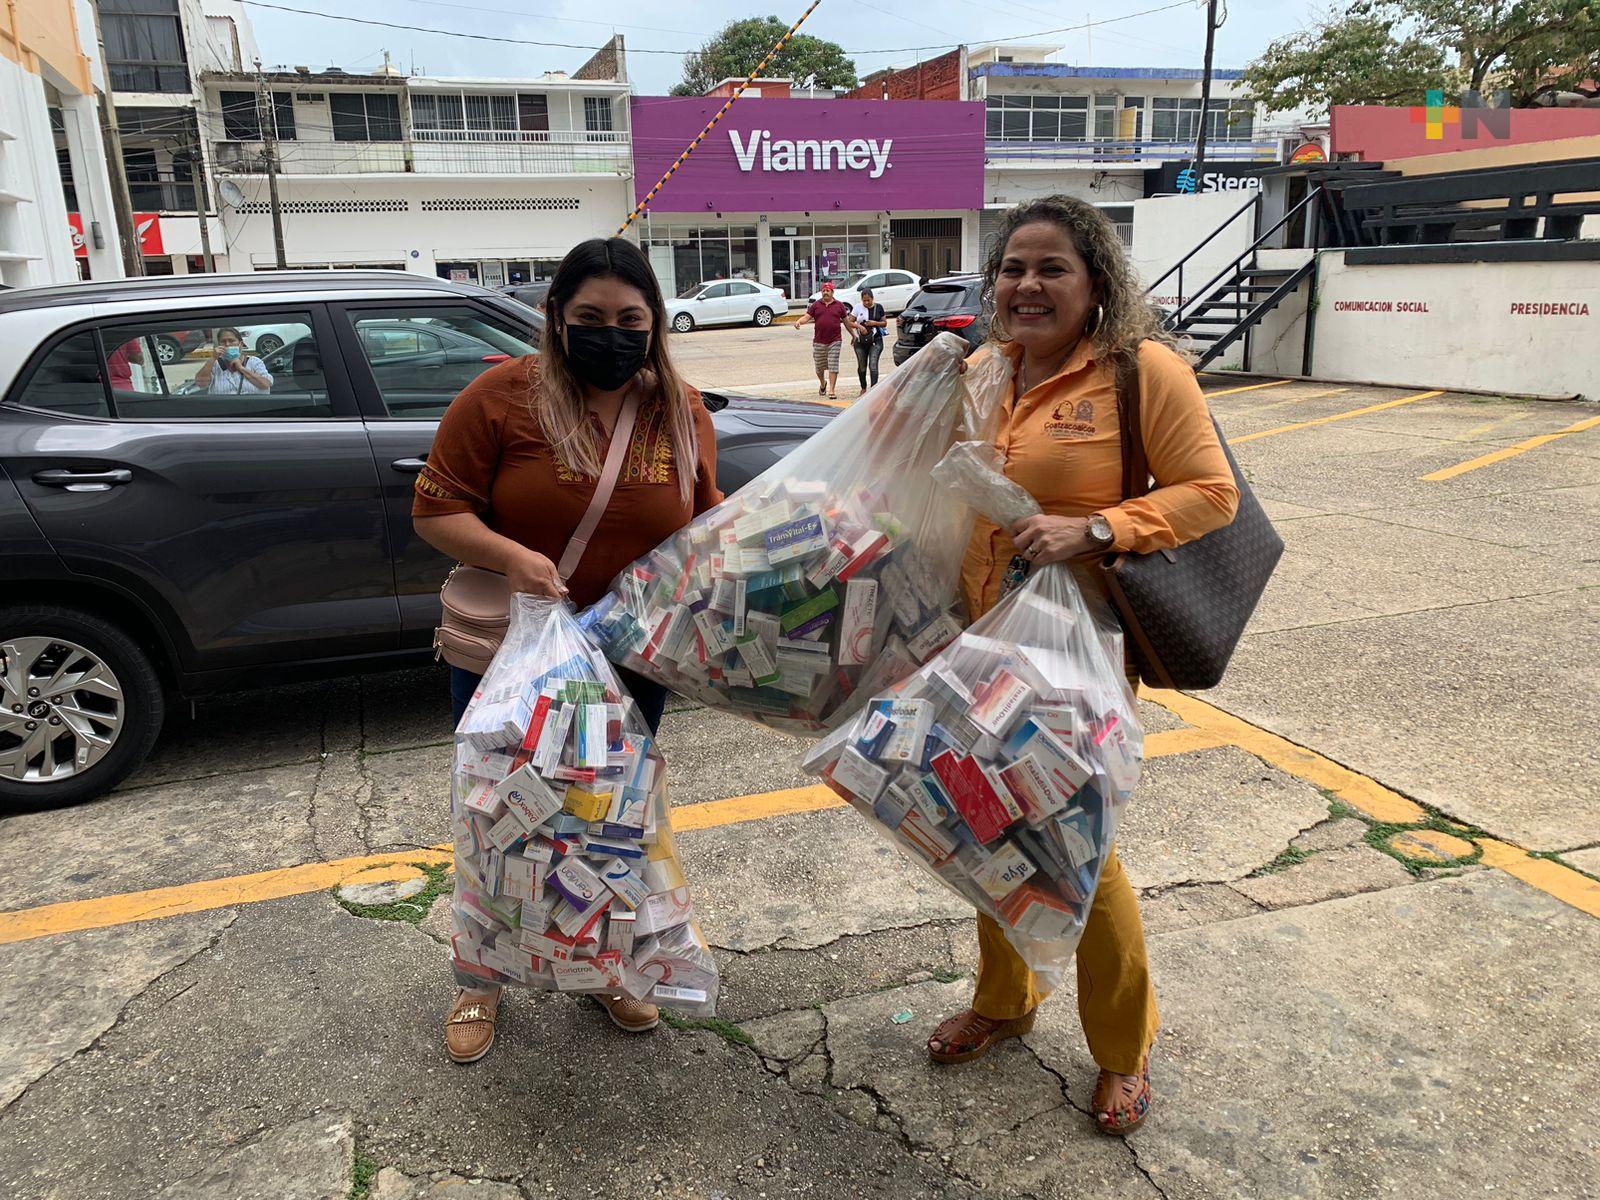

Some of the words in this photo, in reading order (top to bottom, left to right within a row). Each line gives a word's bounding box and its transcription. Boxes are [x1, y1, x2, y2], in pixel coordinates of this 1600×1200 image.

[1334, 301, 1393, 312] COMUNICACION
[1396, 302, 1429, 313] SOCIAL
[1510, 302, 1590, 316] PRESIDENCIA
